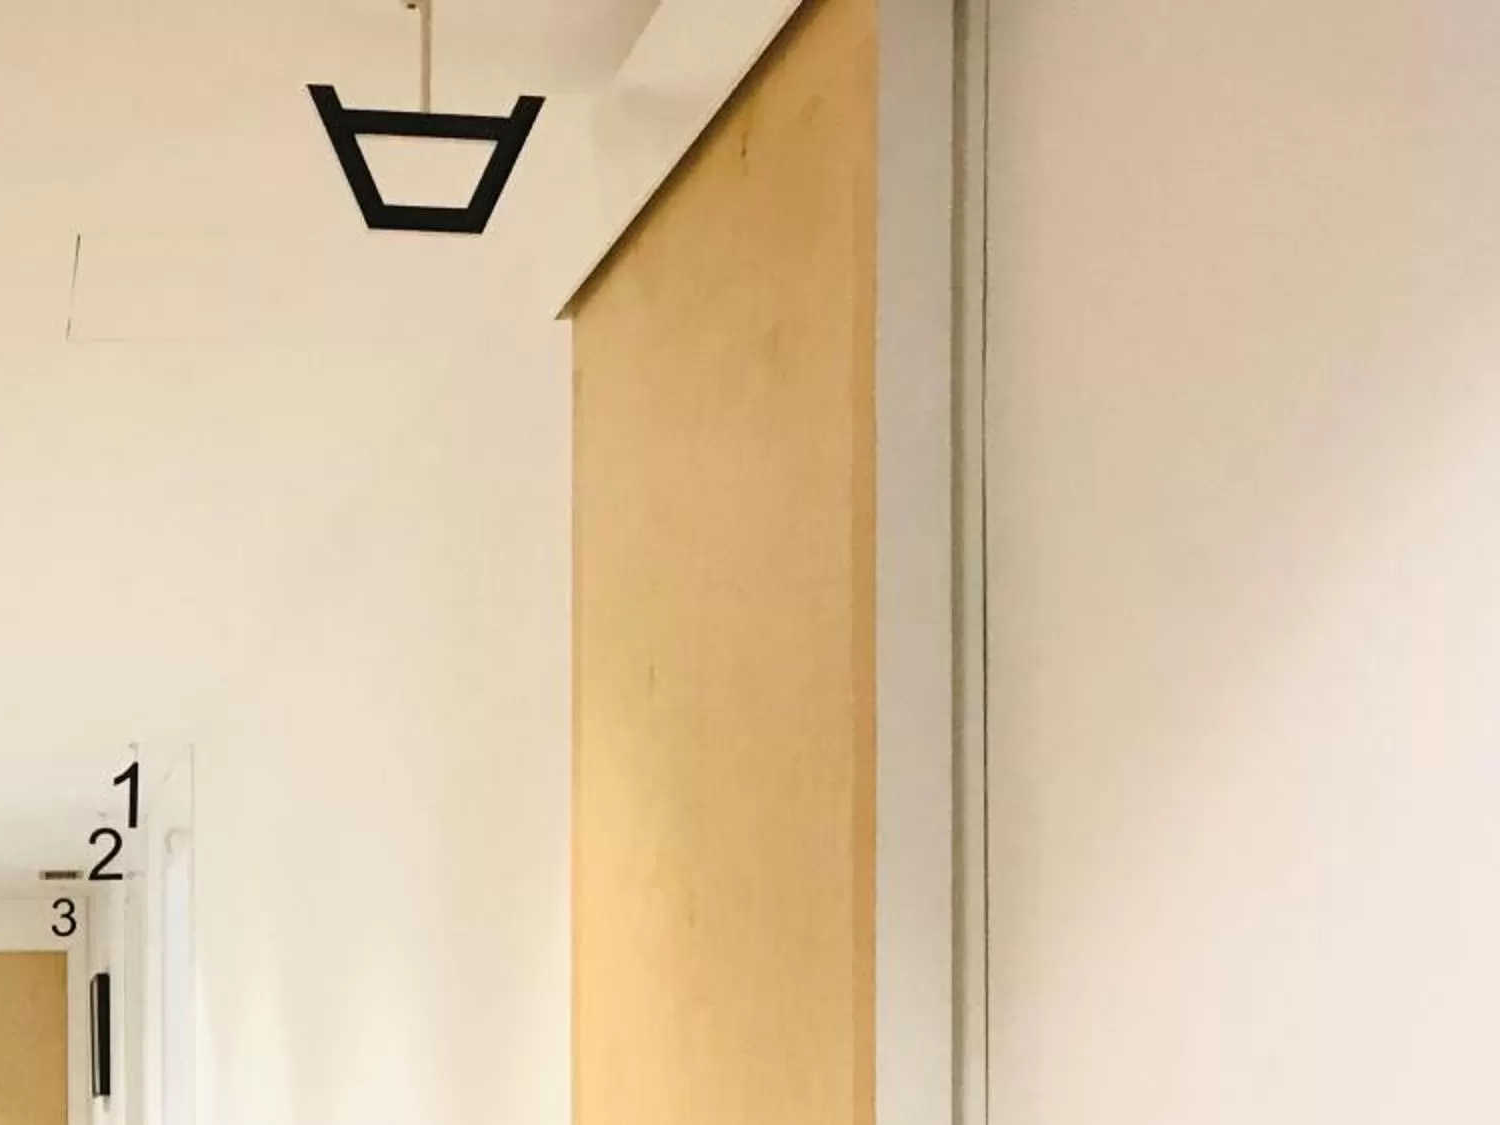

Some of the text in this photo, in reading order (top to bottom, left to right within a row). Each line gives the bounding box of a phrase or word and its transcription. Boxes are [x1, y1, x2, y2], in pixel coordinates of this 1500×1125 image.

[113, 761, 139, 829] 1
[87, 827, 124, 881] 2
[51, 897, 77, 938] 3
